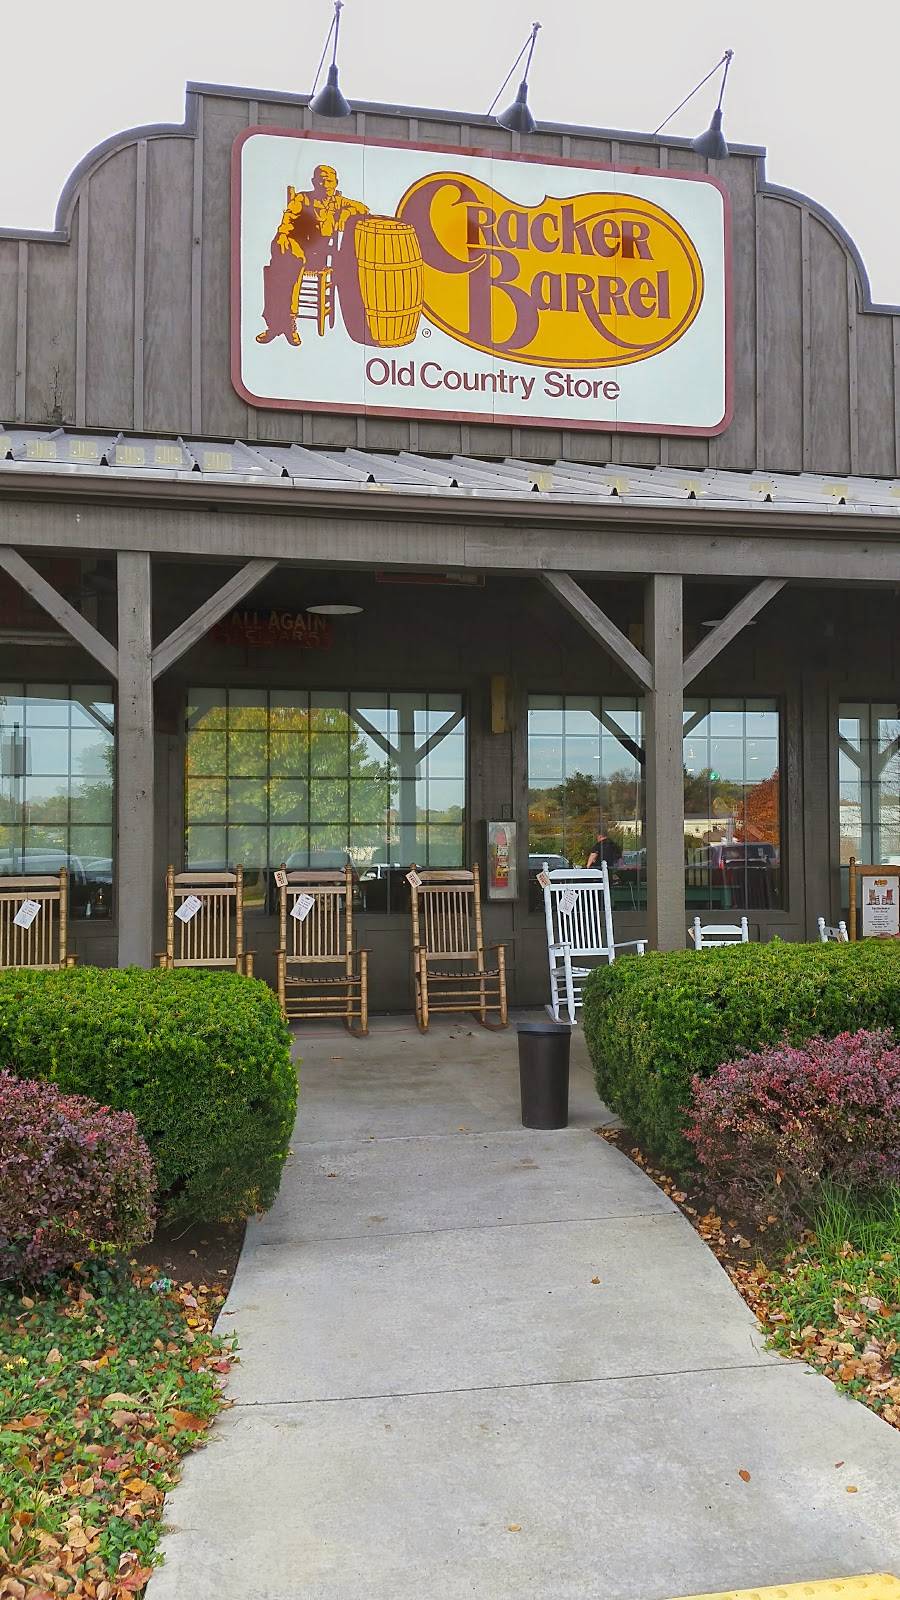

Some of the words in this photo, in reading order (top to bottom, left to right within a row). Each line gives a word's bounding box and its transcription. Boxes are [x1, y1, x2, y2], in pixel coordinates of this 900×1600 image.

[365, 357, 415, 386] Old
[420, 361, 536, 400] Country
[544, 371, 621, 401] Store
[268, 610, 327, 631] AGAIN
